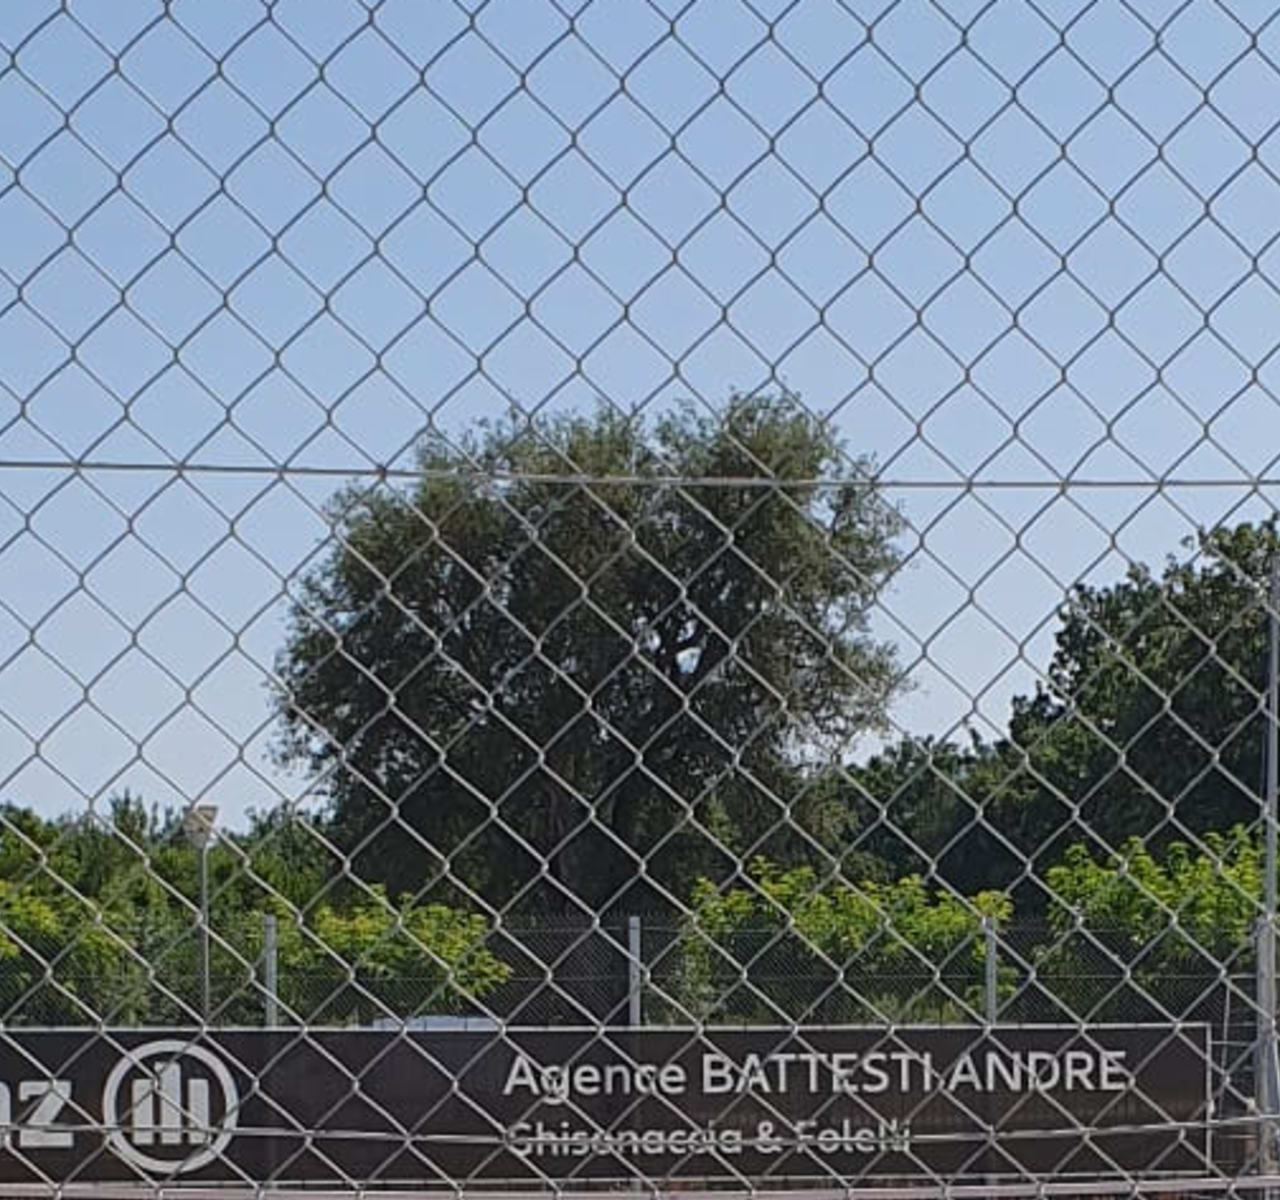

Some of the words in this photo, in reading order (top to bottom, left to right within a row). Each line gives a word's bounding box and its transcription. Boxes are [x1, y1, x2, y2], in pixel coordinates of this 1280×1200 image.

[503, 1054, 687, 1106] Agence
[702, 1053, 932, 1093] BATTESTI
[948, 1051, 1127, 1092] ANDRE
[754, 1121, 783, 1154] &
